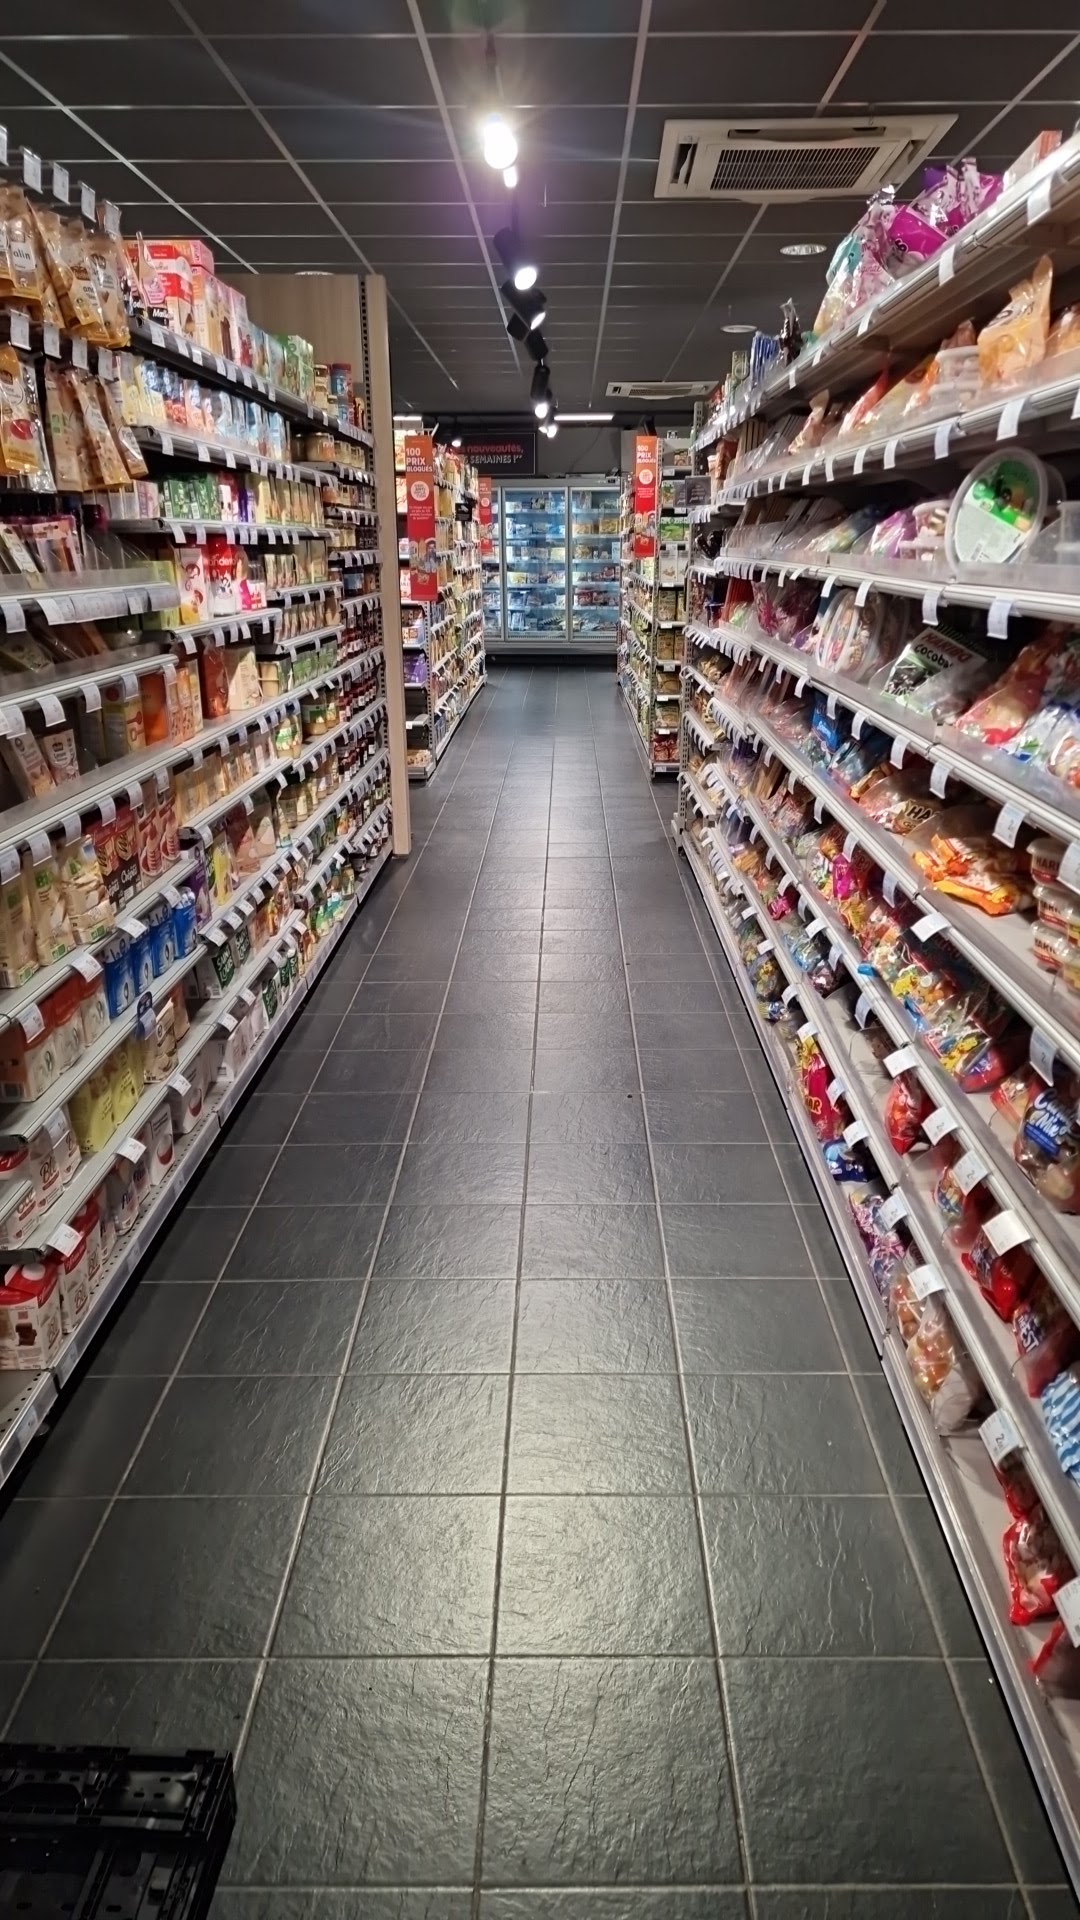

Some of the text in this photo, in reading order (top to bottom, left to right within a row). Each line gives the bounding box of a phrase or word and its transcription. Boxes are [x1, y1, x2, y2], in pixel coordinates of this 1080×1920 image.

[406, 447, 421, 456] 100
[467, 444, 524, 454] nouveautés,
[406, 457, 426, 465] PRIX
[470, 455, 511, 464] SEMAINES
[921, 632, 973, 663] HARIBO
